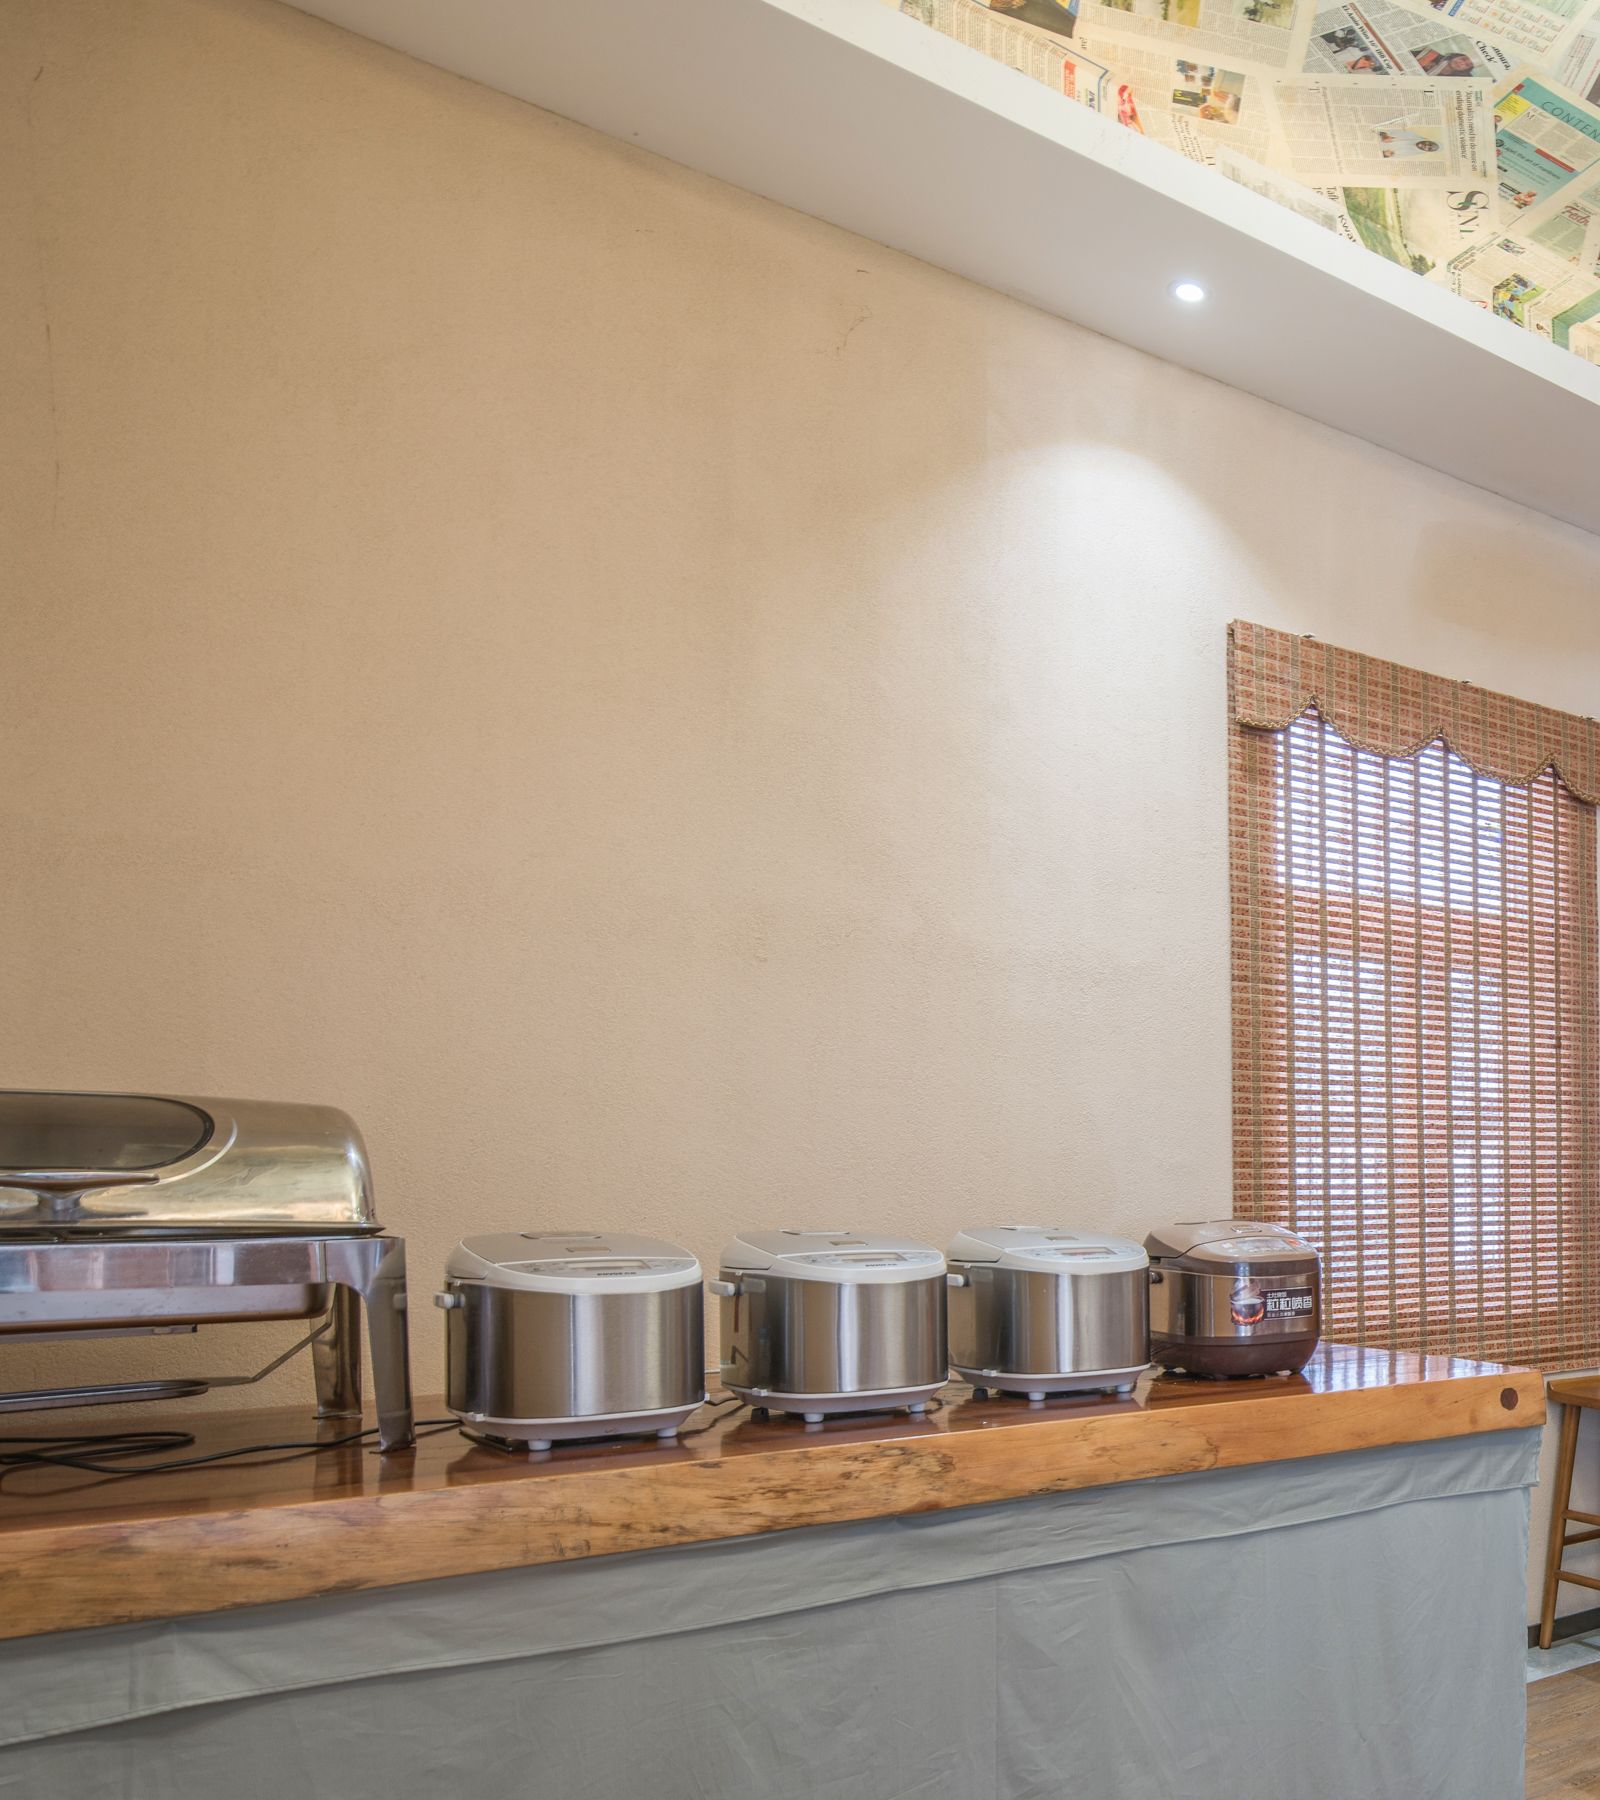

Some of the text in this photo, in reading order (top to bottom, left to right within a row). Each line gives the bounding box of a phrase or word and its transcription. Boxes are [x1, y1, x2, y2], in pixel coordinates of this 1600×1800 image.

[1382, 58, 1393, 70] Cup
[1454, 90, 1464, 111] ending
[1457, 110, 1466, 135] domestic
[1467, 121, 1476, 135] need
[1266, 1295, 1312, 1310] 粒粒喷香
